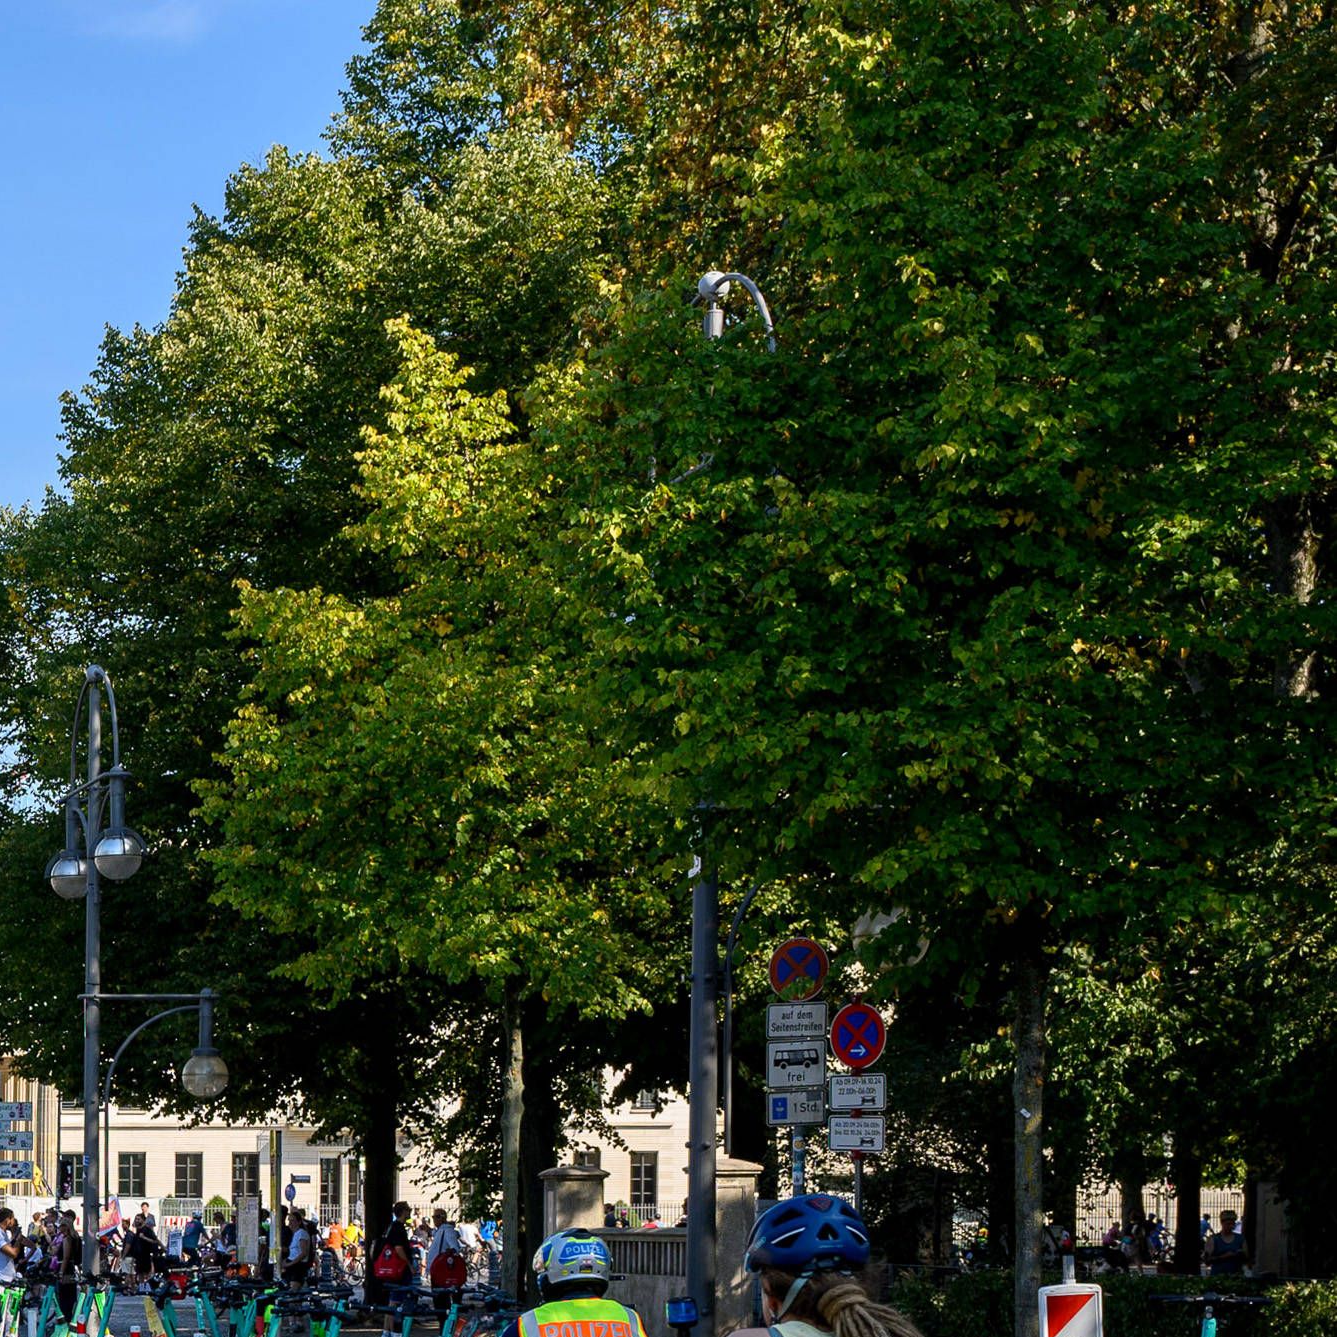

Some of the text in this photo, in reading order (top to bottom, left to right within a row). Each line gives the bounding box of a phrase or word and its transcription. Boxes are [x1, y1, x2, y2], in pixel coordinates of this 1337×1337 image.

[781, 1010, 813, 1019] auf dem
[771, 1022, 823, 1033] Seitenstreifen
[787, 1071, 805, 1082] frei
[798, 1102, 820, 1113] Std.
[566, 1244, 604, 1255] POLIZEI
